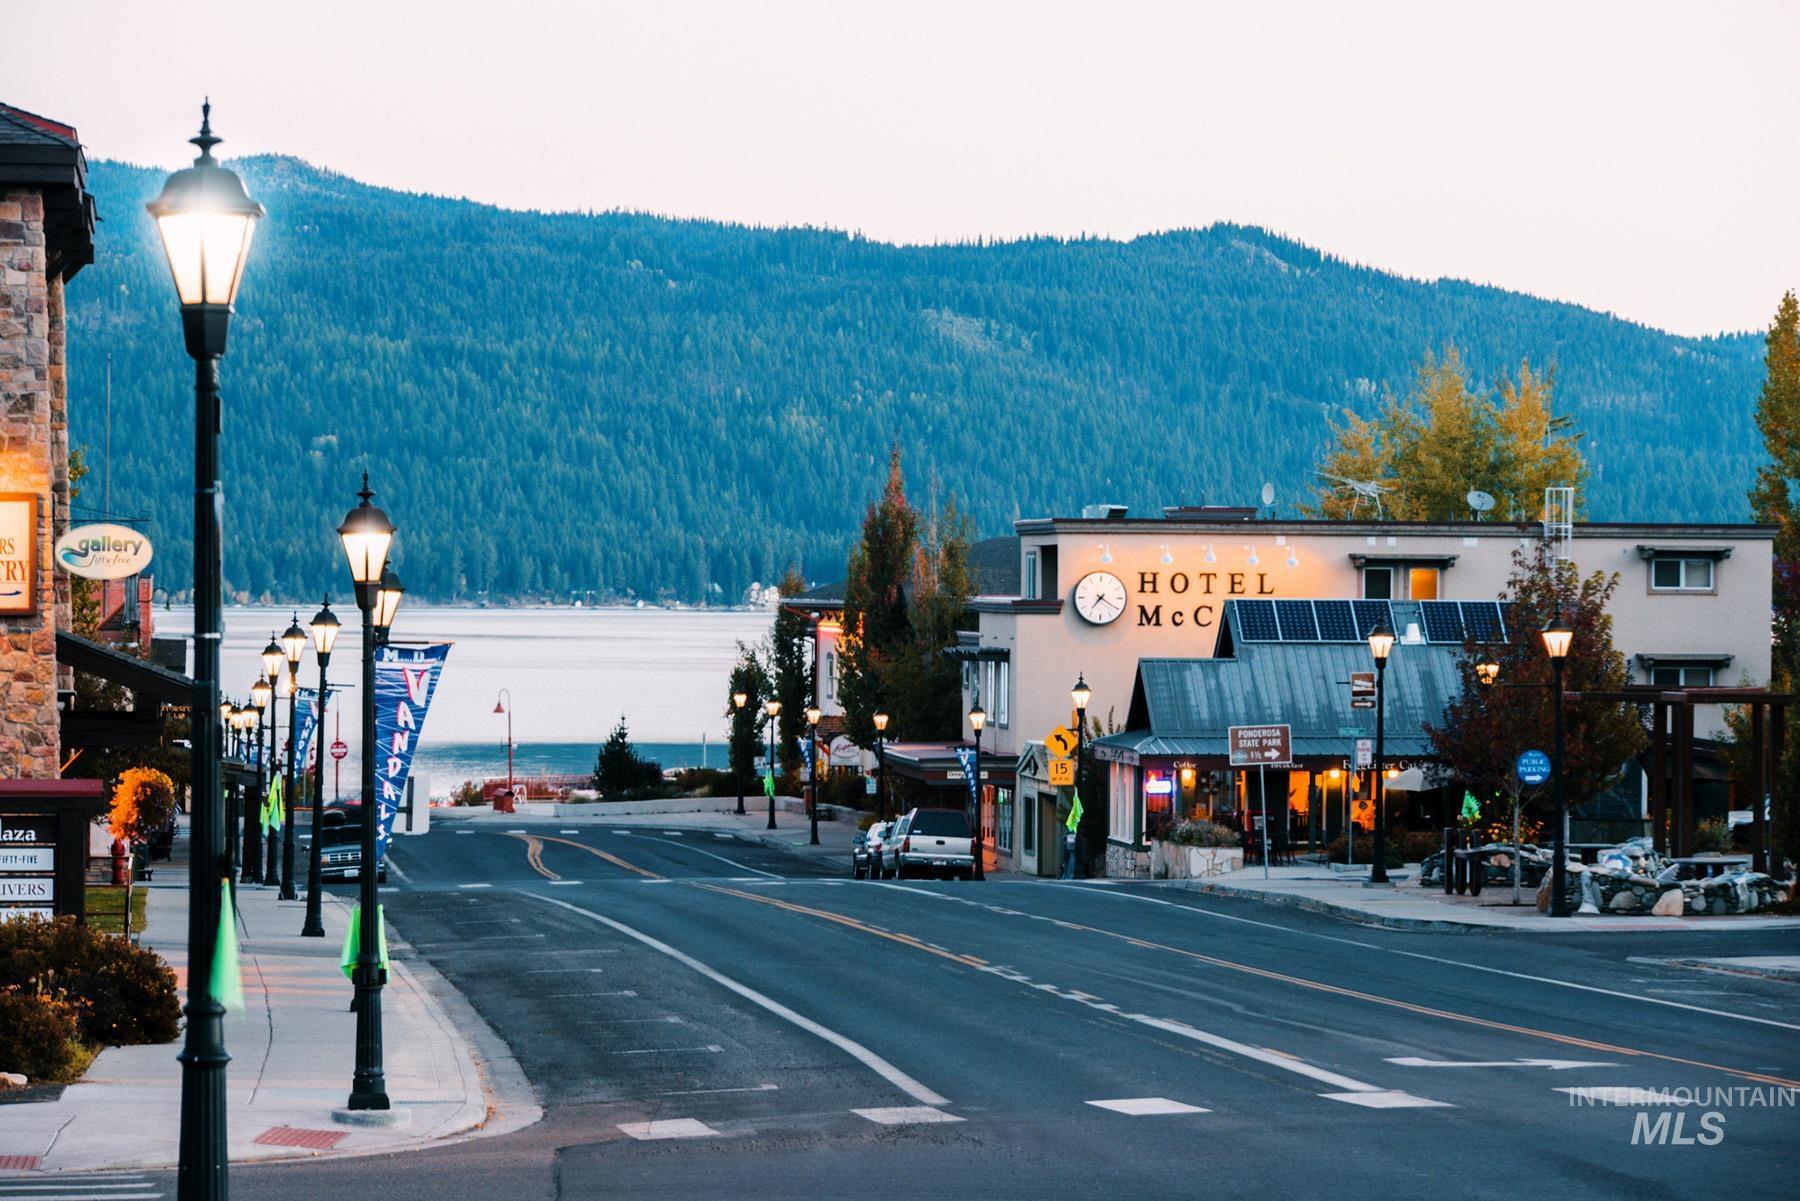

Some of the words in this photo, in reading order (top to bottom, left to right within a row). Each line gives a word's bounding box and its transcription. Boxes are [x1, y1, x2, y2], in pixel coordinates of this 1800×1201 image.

[78, 535, 143, 557] gallery
[1137, 572, 1275, 594] HOTEL
[1137, 605, 1213, 627] McC
[1238, 729, 1281, 739] PONDEROSA
[1238, 739, 1260, 748] STATE
[1262, 738, 1282, 747] PARK
[376, 667, 431, 841] VANDALS
[1055, 763, 1068, 775] 15
[1173, 760, 1198, 769] Coffee
[0, 883, 46, 896] IVERS
